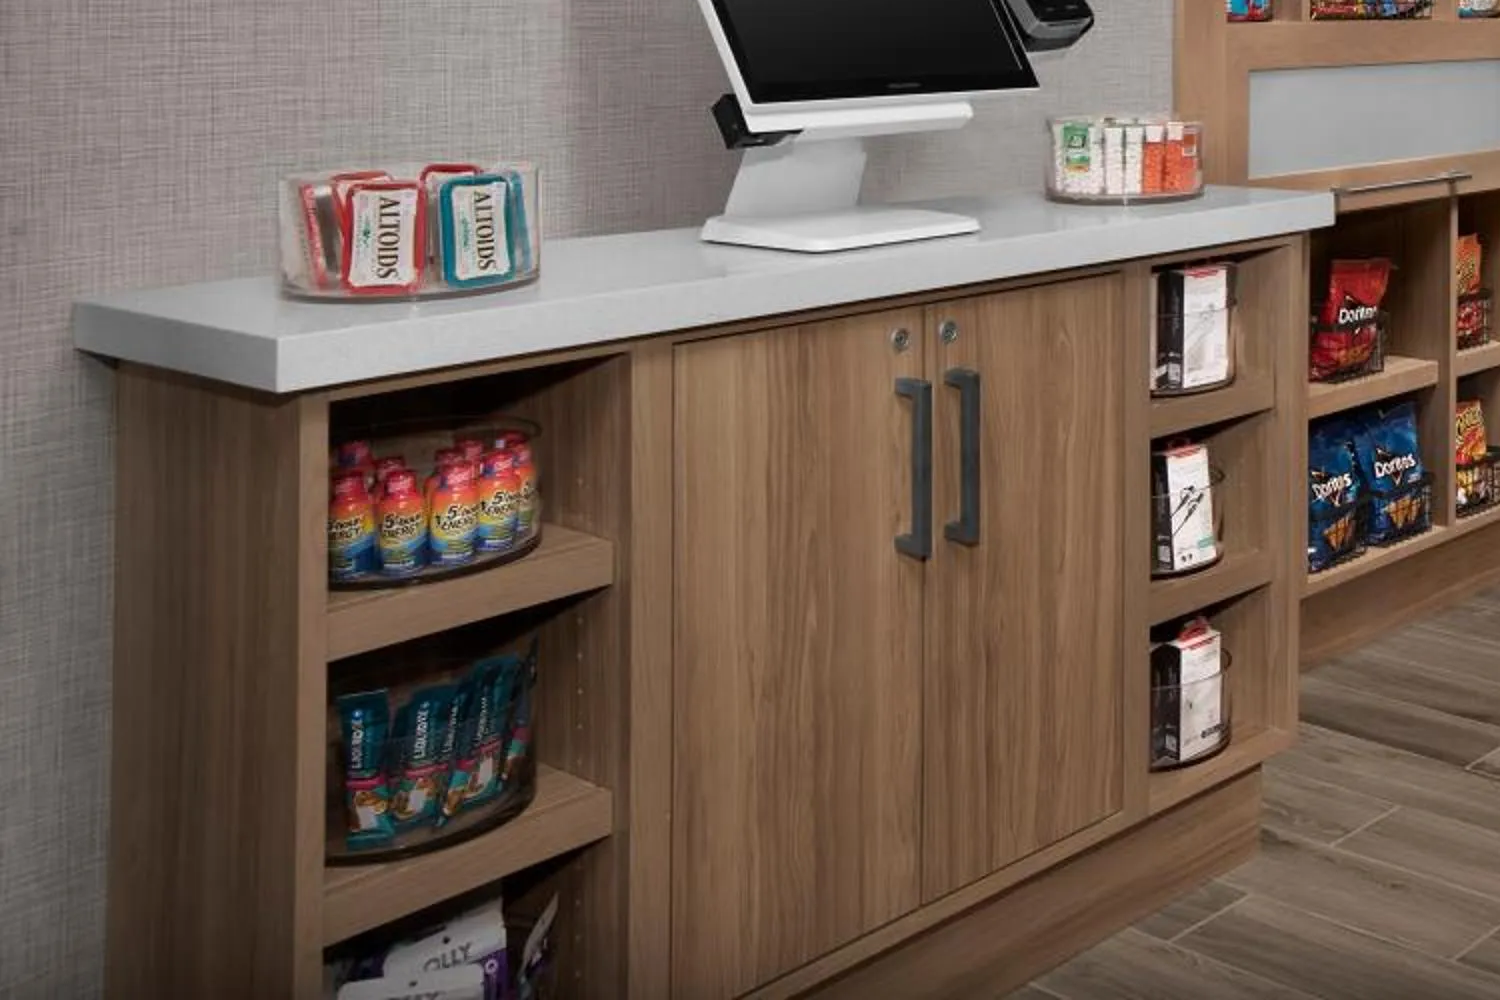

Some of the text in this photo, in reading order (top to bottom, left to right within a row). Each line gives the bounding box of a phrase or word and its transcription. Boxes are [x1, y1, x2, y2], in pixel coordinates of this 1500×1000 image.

[377, 196, 401, 279] ALTOIDS
[474, 191, 496, 271] ALTOIDS
[1374, 453, 1417, 479] Doritos
[423, 942, 473, 971] OLLY
